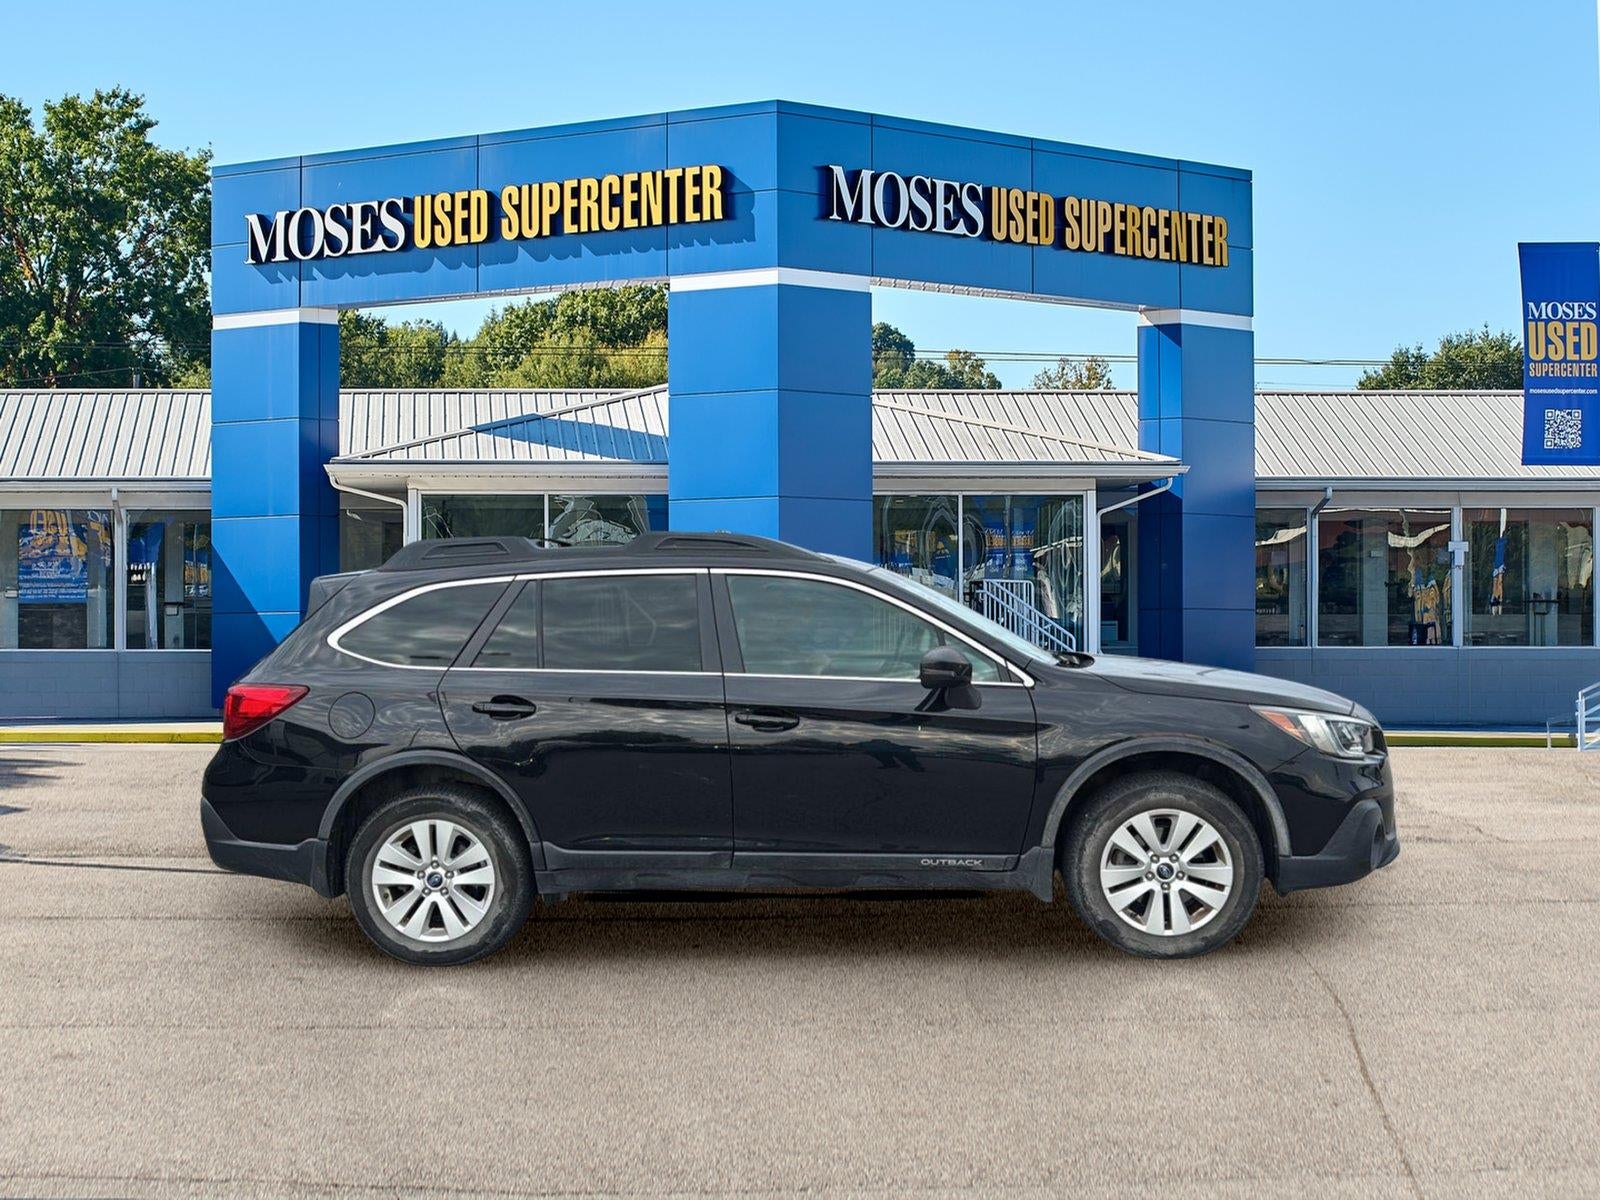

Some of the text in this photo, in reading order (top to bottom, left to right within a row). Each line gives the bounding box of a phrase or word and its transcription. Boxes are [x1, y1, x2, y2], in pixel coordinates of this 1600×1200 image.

[245, 164, 724, 264] MOSES USED SUPERCENTER
[829, 164, 1229, 267] MOSES USED SUPERCENTER
[1527, 301, 1597, 320] MOSES
[1528, 321, 1598, 361] USED
[1529, 362, 1598, 378] SUPERCENTER
[920, 858, 983, 867] OUTBACK
